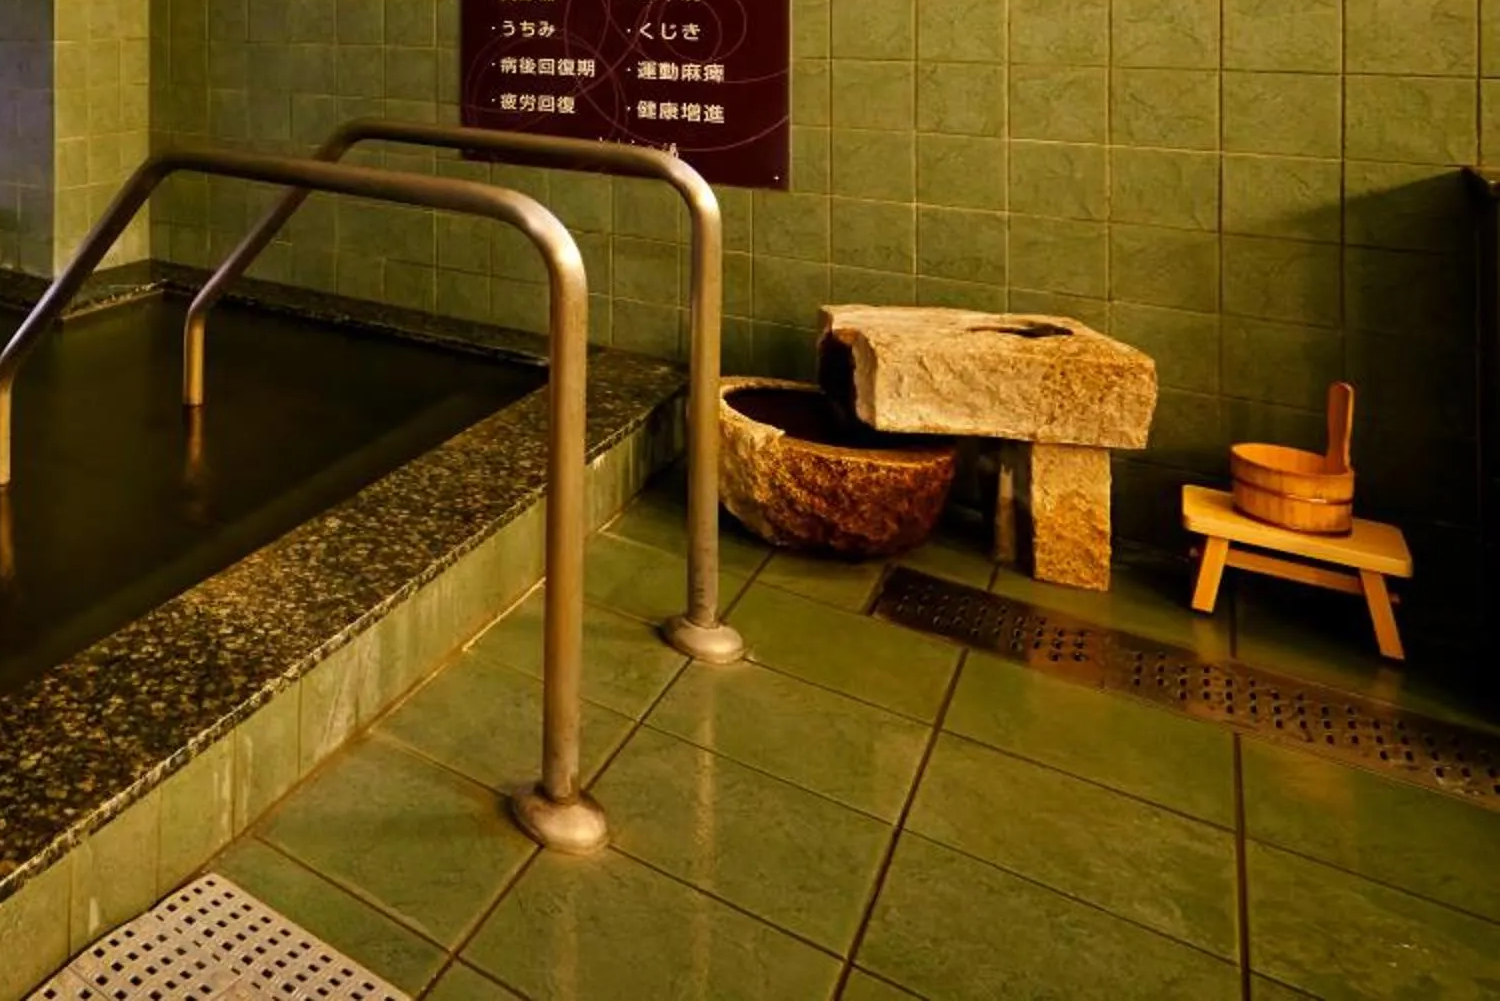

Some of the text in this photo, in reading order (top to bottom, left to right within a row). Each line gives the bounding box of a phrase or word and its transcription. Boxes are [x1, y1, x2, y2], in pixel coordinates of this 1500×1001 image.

[502, 20, 556, 38] うちみ
[638, 22, 702, 41] くじき
[500, 56, 596, 78] 病後回復期
[500, 93, 576, 114] 疲労回復
[637, 100, 725, 124] 健康増進
